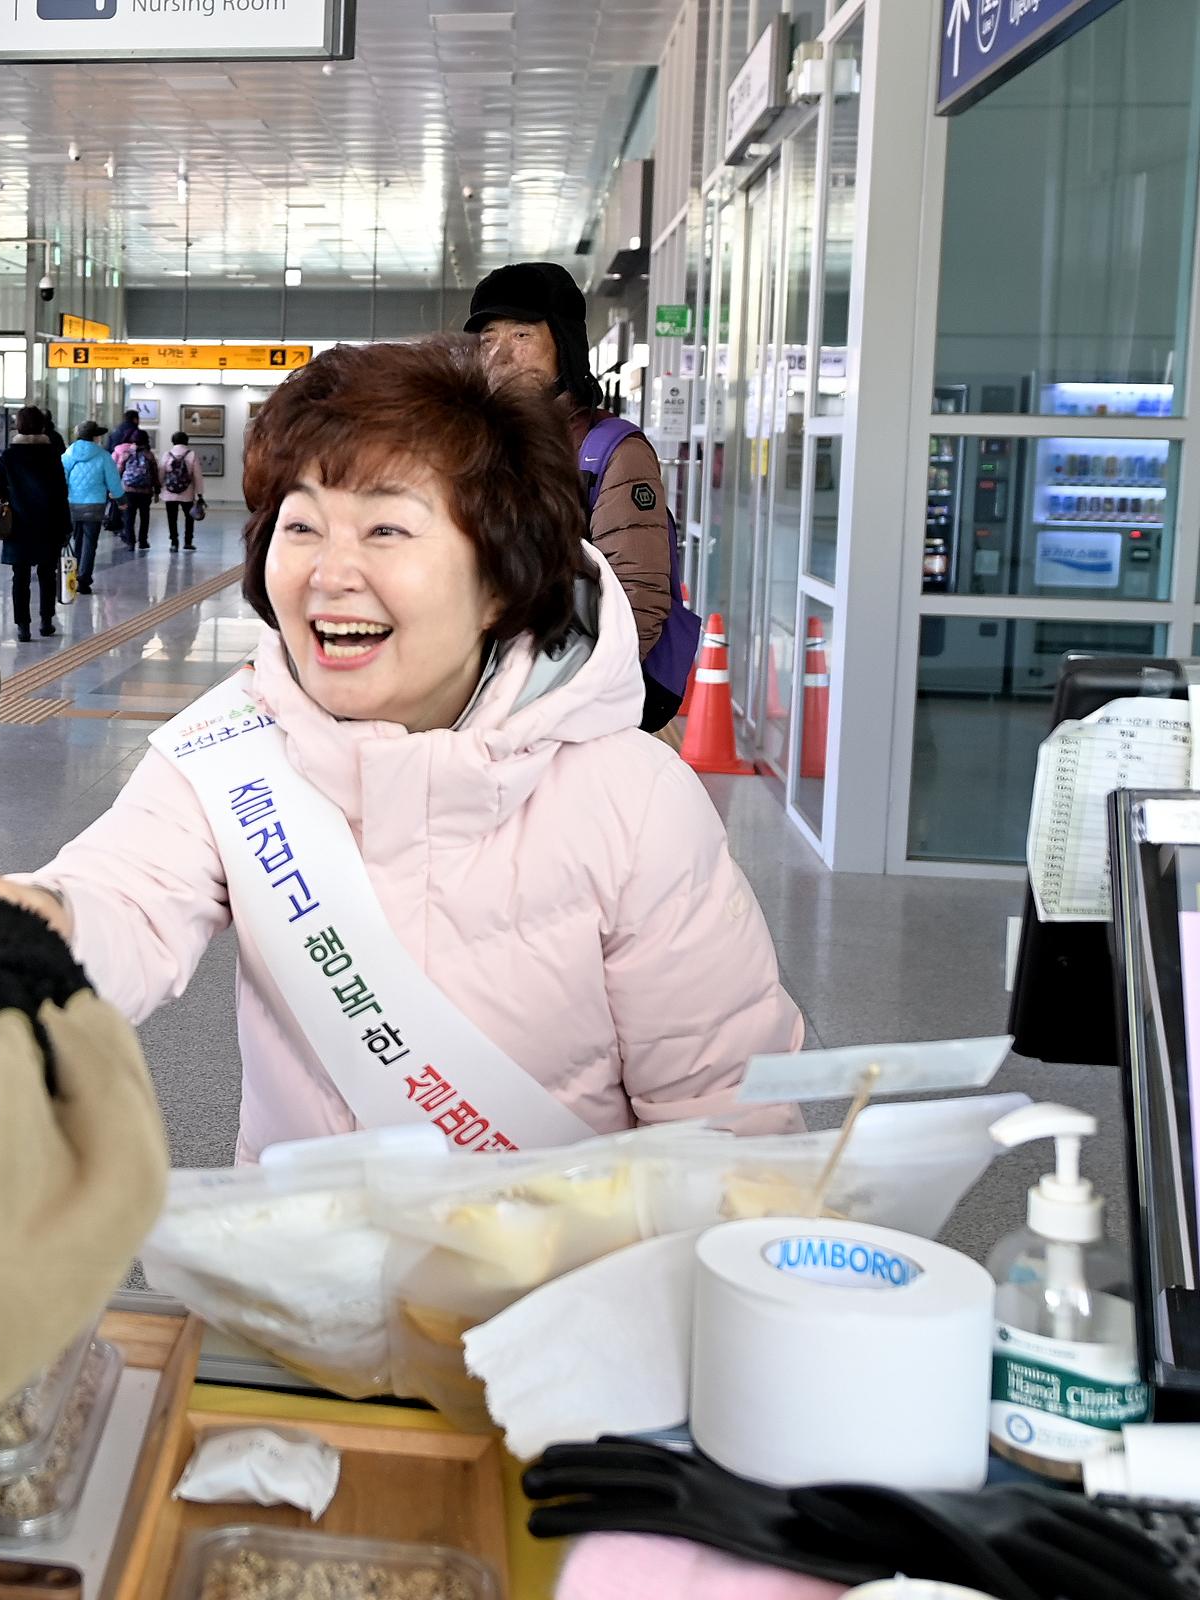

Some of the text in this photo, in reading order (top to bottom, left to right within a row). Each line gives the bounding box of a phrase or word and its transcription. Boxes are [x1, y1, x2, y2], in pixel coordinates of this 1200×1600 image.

[132, 0, 215, 16] Nursing
[76, 348, 87, 362] 3
[272, 351, 284, 364] 4
[228, 777, 321, 924] 즐겁고
[303, 925, 411, 1067] 행복한
